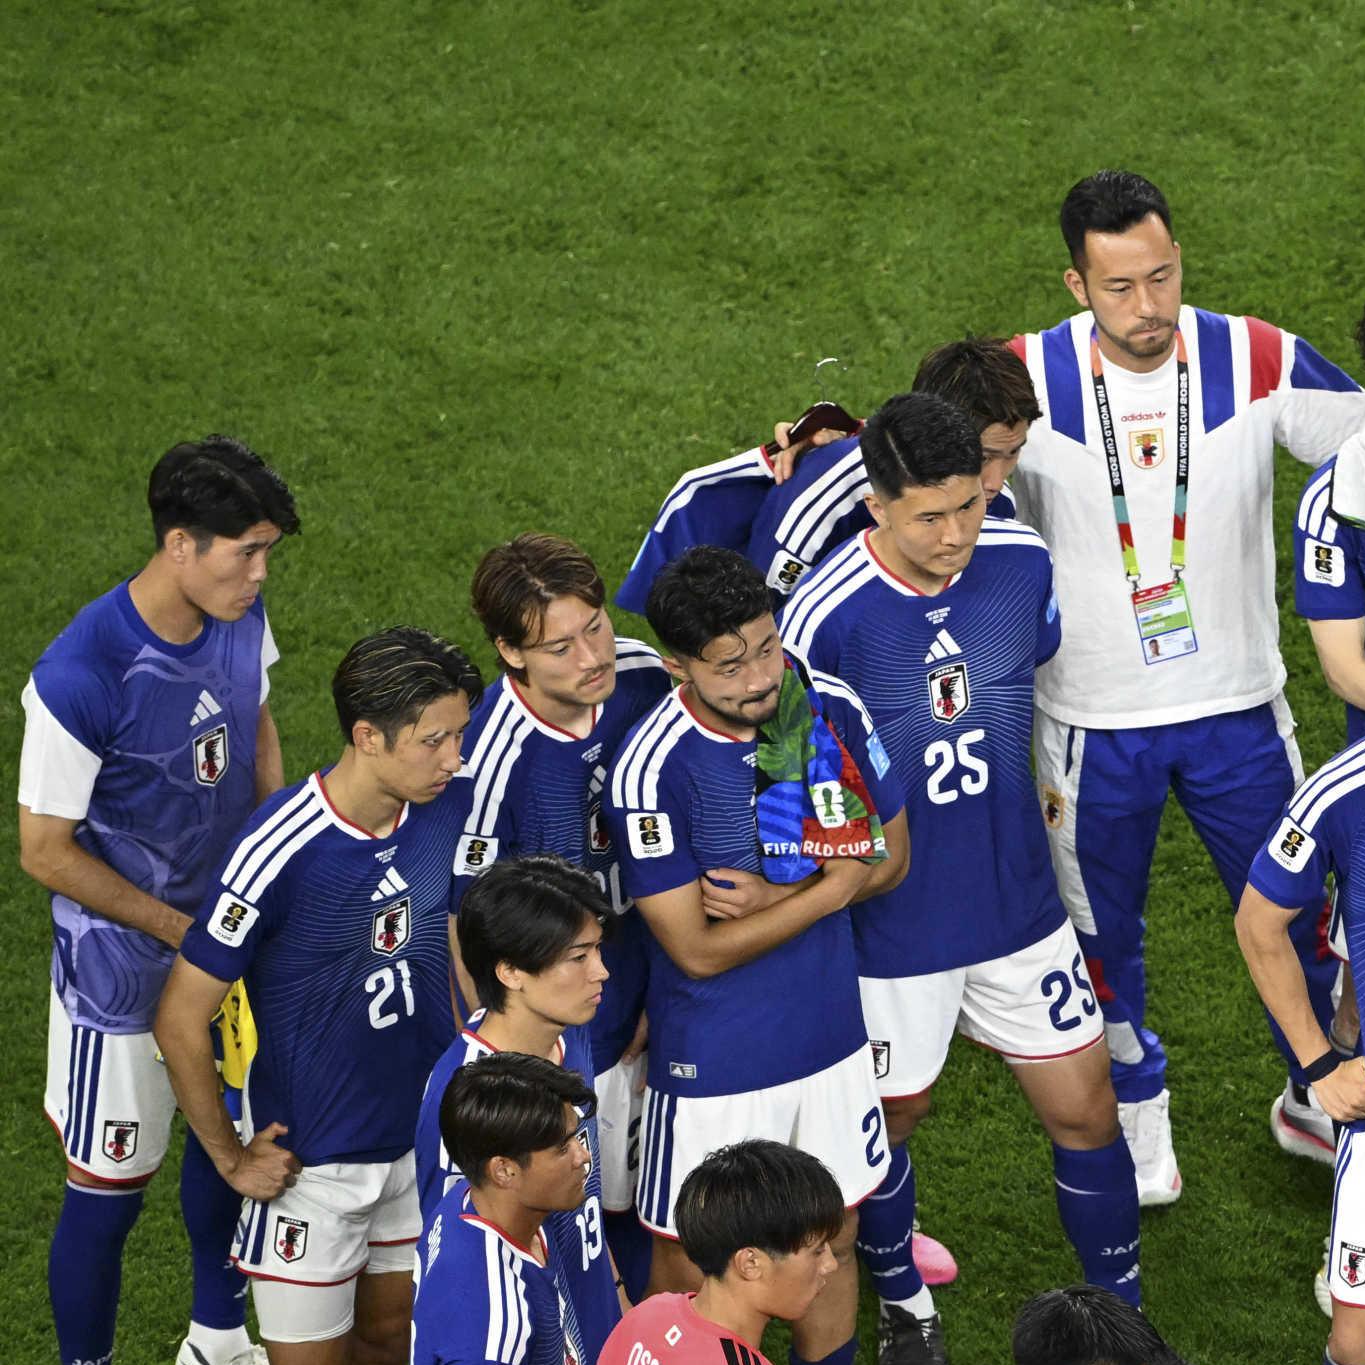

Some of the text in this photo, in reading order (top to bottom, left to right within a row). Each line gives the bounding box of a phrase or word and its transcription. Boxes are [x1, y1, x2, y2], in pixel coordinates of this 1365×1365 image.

[1095, 384, 1107, 406] FIFA
[1179, 373, 1188, 405] 2026
[1098, 405, 1113, 436] WORLD
[1120, 412, 1154, 424] adidas
[1179, 420, 1188, 455] WORLD
[1109, 451, 1122, 487] 2026
[1178, 455, 1187, 477] FIFA
[934, 666, 956, 678] JAPAN
[924, 728, 988, 805] 25
[763, 842, 800, 857] FIFA
[803, 841, 835, 857] RLD
[837, 840, 871, 857] CUP
[365, 959, 416, 1030] 21
[575, 1195, 603, 1272] 13
